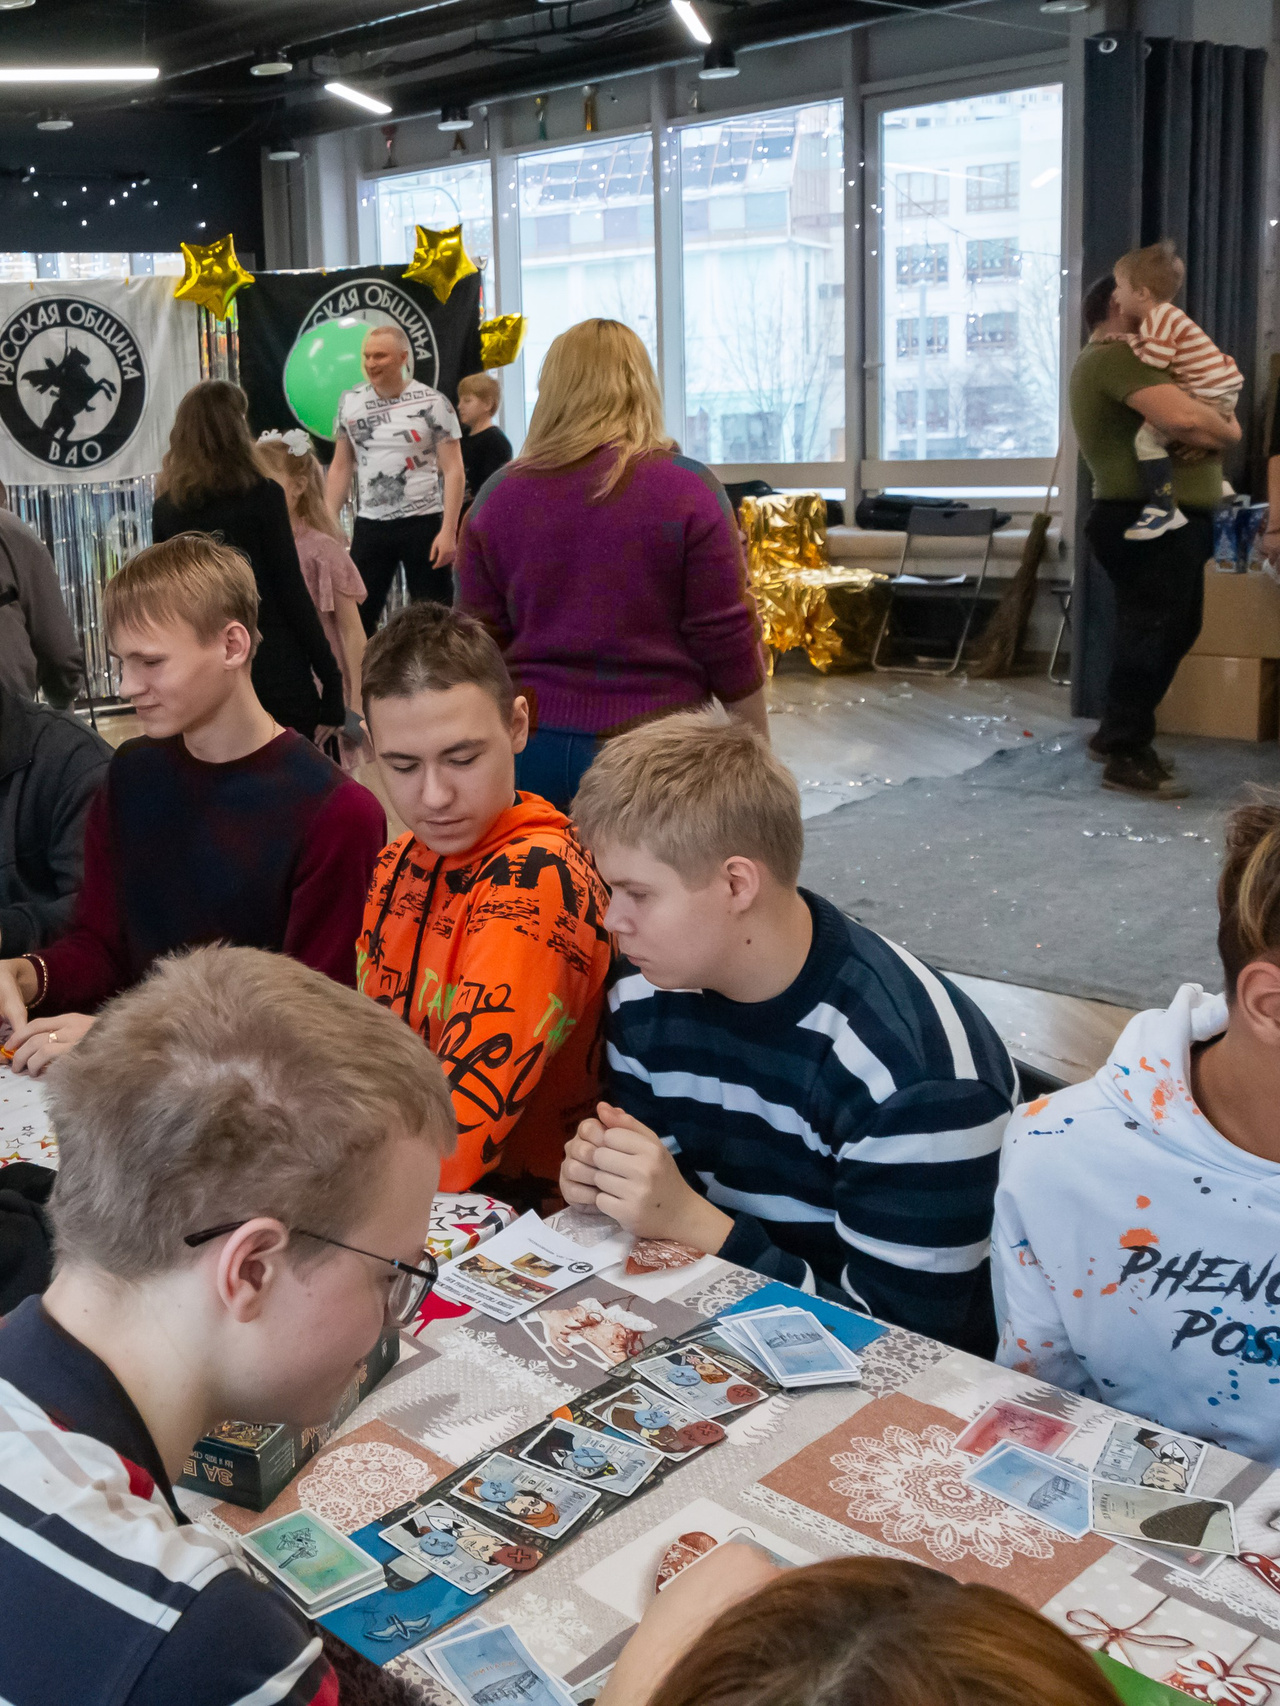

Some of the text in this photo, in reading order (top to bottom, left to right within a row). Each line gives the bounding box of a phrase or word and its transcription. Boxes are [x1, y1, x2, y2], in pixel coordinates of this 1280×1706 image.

[66, 303, 141, 380] ОБЩИНА
[365, 285, 432, 360] ОБЩИНА
[1171, 1308, 1280, 1365] POS
